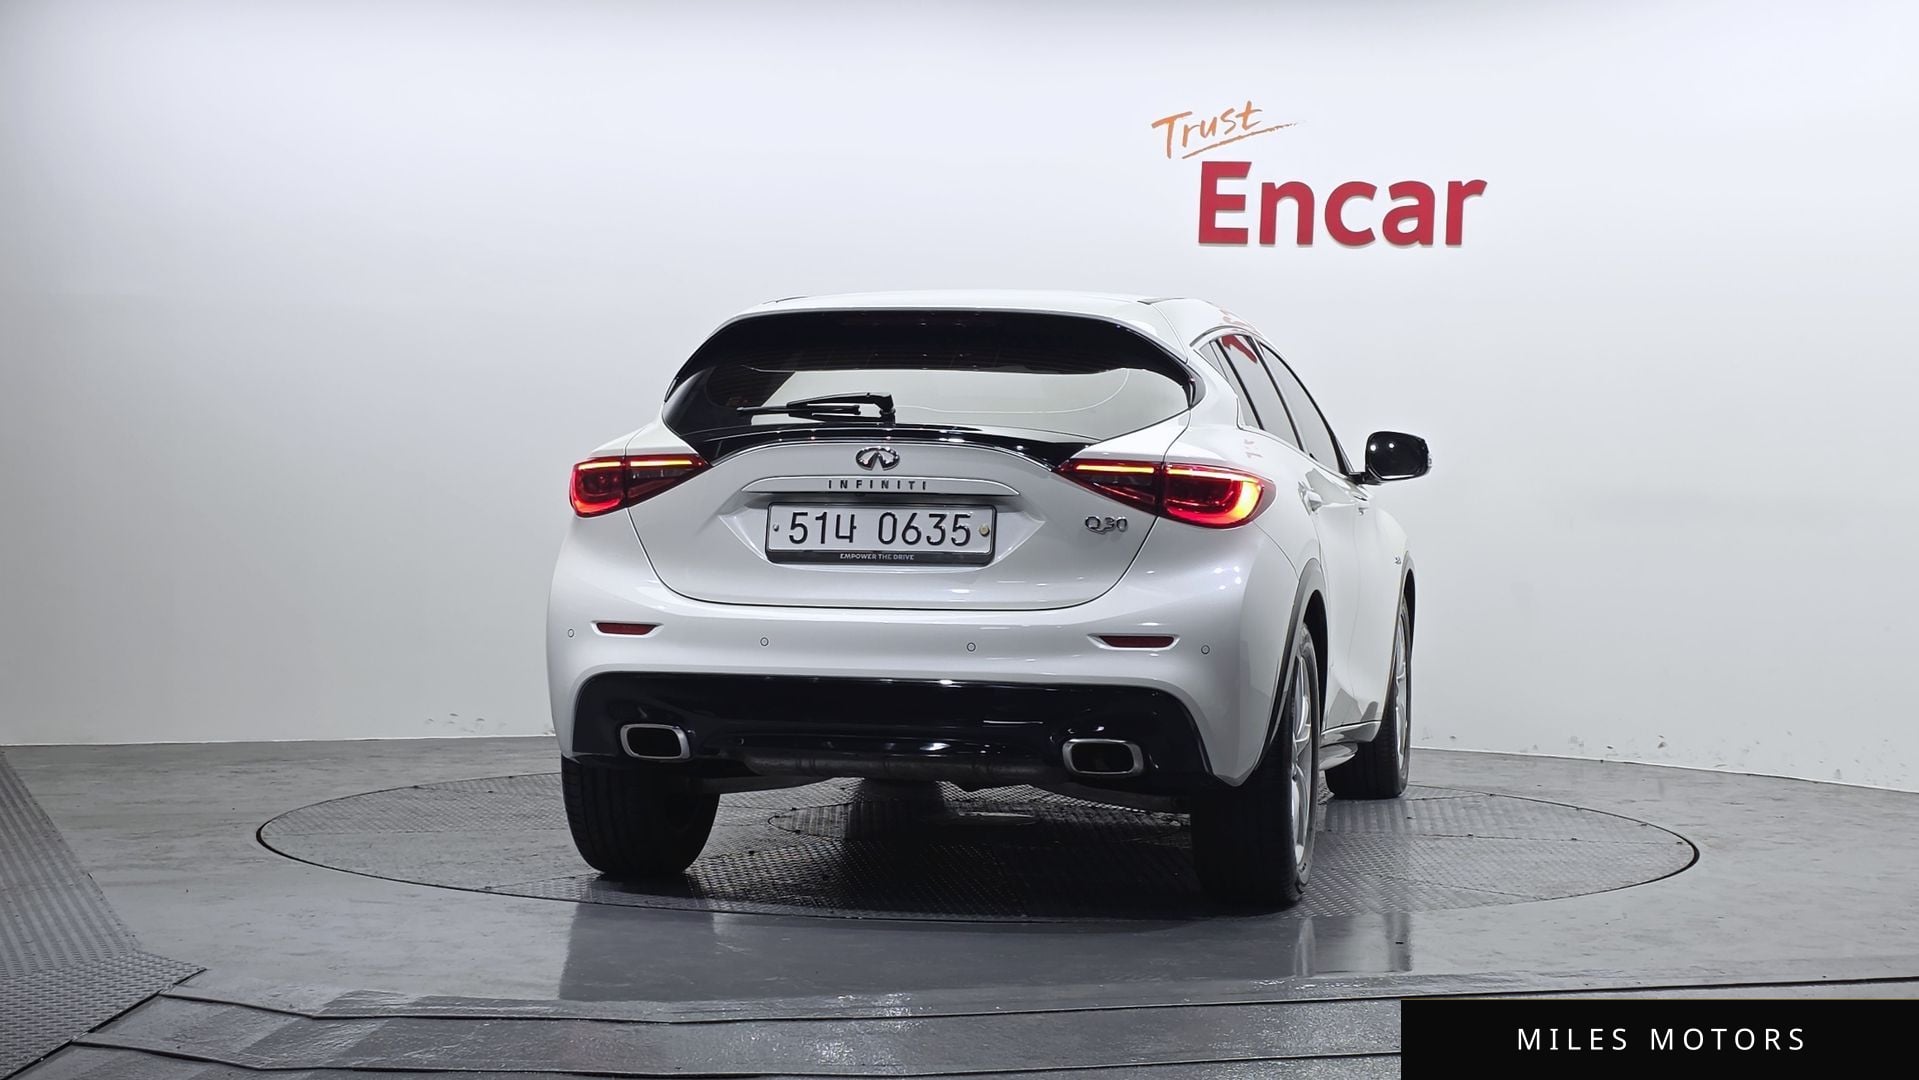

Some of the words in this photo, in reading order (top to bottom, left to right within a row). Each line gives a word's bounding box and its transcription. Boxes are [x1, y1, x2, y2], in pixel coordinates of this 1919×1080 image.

[1151, 100, 1263, 159] Trust
[1198, 160, 1488, 249] Encar
[828, 479, 926, 490] INFINITI
[788, 511, 857, 545] 51나
[878, 512, 971, 546] 0635
[1085, 515, 1128, 534] Q30
[839, 552, 877, 560] EMPOWER
